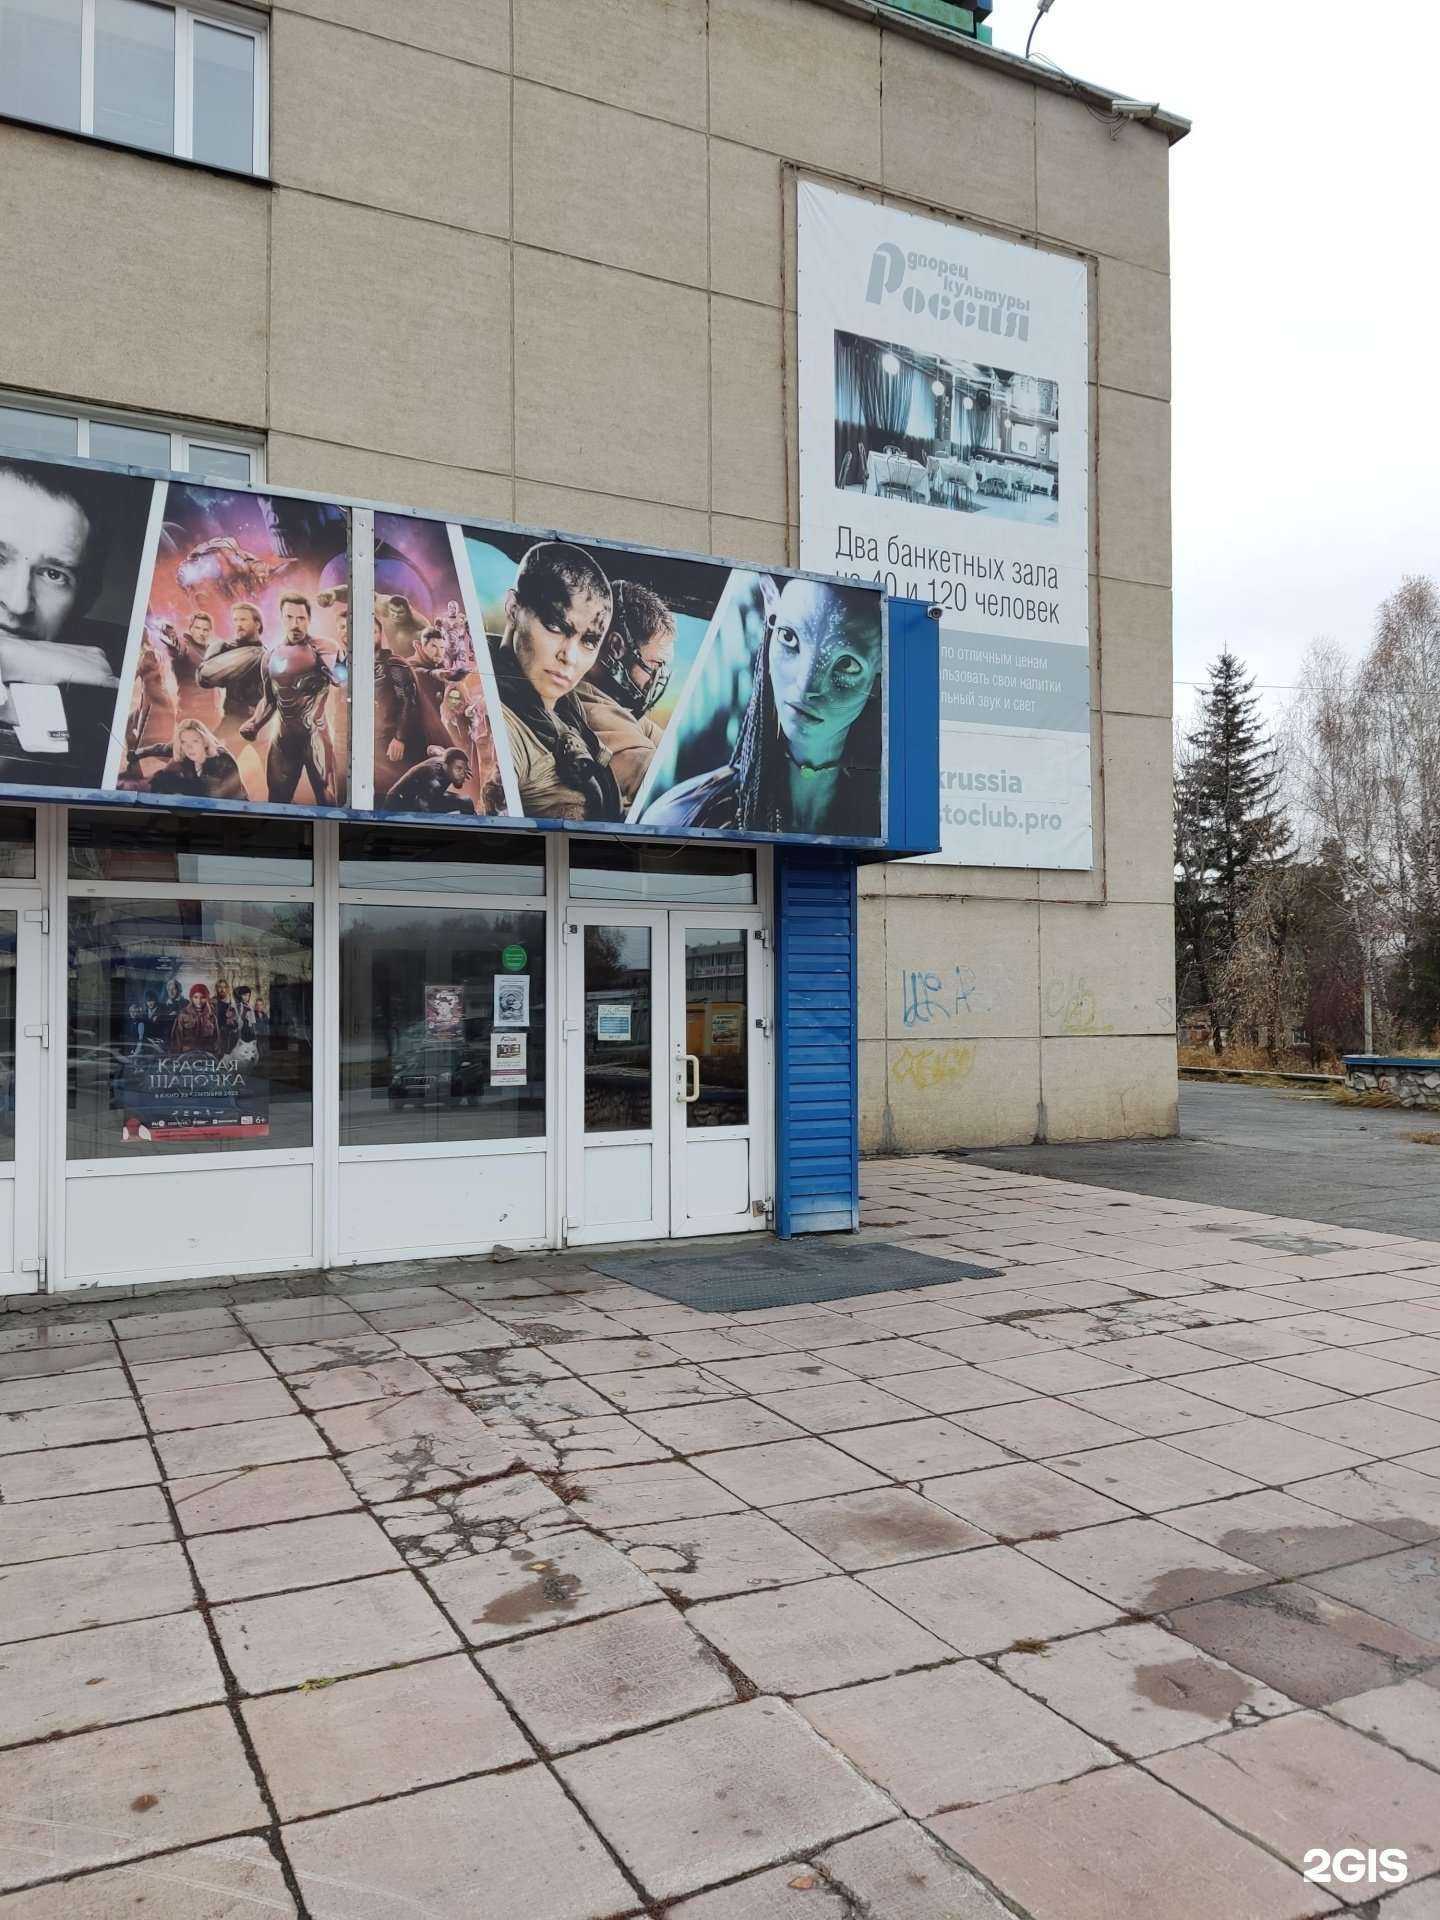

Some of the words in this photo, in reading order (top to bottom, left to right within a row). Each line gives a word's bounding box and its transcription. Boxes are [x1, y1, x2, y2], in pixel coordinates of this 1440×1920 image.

[906, 251, 969, 281] дворец
[865, 242, 1030, 342] Россия
[943, 275, 1030, 312] культуры
[835, 525, 879, 562] Два
[887, 534, 1005, 582] банкетных
[1011, 561, 1059, 590] зала
[906, 581, 919, 600] и
[927, 578, 967, 612] 120
[975, 591, 1060, 625] человек
[957, 647, 1012, 665] отличным
[1015, 655, 1048, 671] ценам
[939, 667, 990, 686] льзовать
[992, 673, 1017, 689] свои
[1020, 677, 1062, 694] напитки
[977, 694, 1002, 712] звук
[1013, 699, 1036, 713] свет
[940, 802, 1063, 835] toclub.pro
[158, 1057, 240, 1074] КРАСНАЯ
[149, 1073, 247, 1092] ШАПОЧКА
